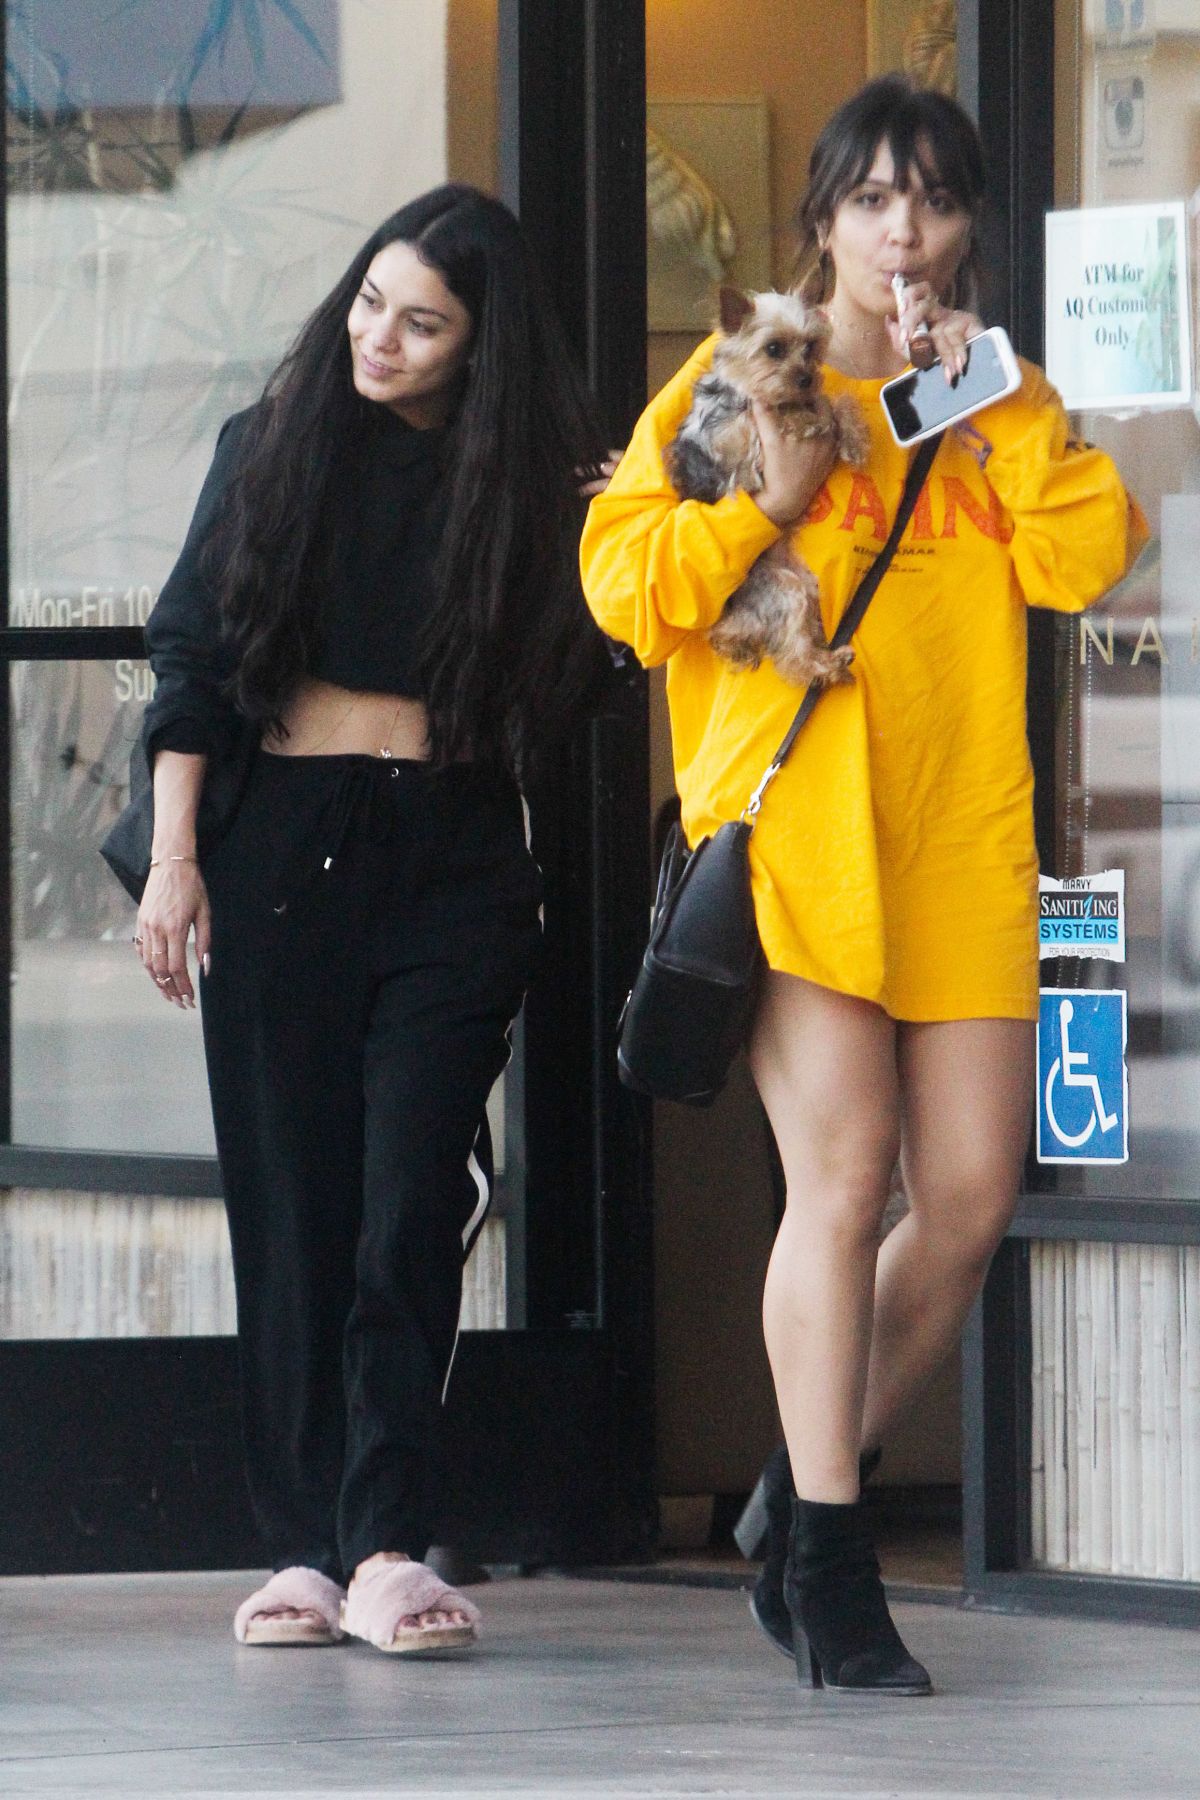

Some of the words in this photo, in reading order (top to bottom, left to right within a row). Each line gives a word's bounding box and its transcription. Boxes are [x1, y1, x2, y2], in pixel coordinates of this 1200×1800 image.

[1084, 263, 1118, 285] ATM
[1121, 263, 1145, 283] for
[1064, 296, 1085, 320] AQ
[1095, 325, 1130, 350] Only
[16, 585, 114, 627] Mon-Fri
[1062, 878, 1092, 890] MARVY
[1040, 894, 1118, 919] SANITIZING
[1040, 923, 1118, 939] SYSTEMS
